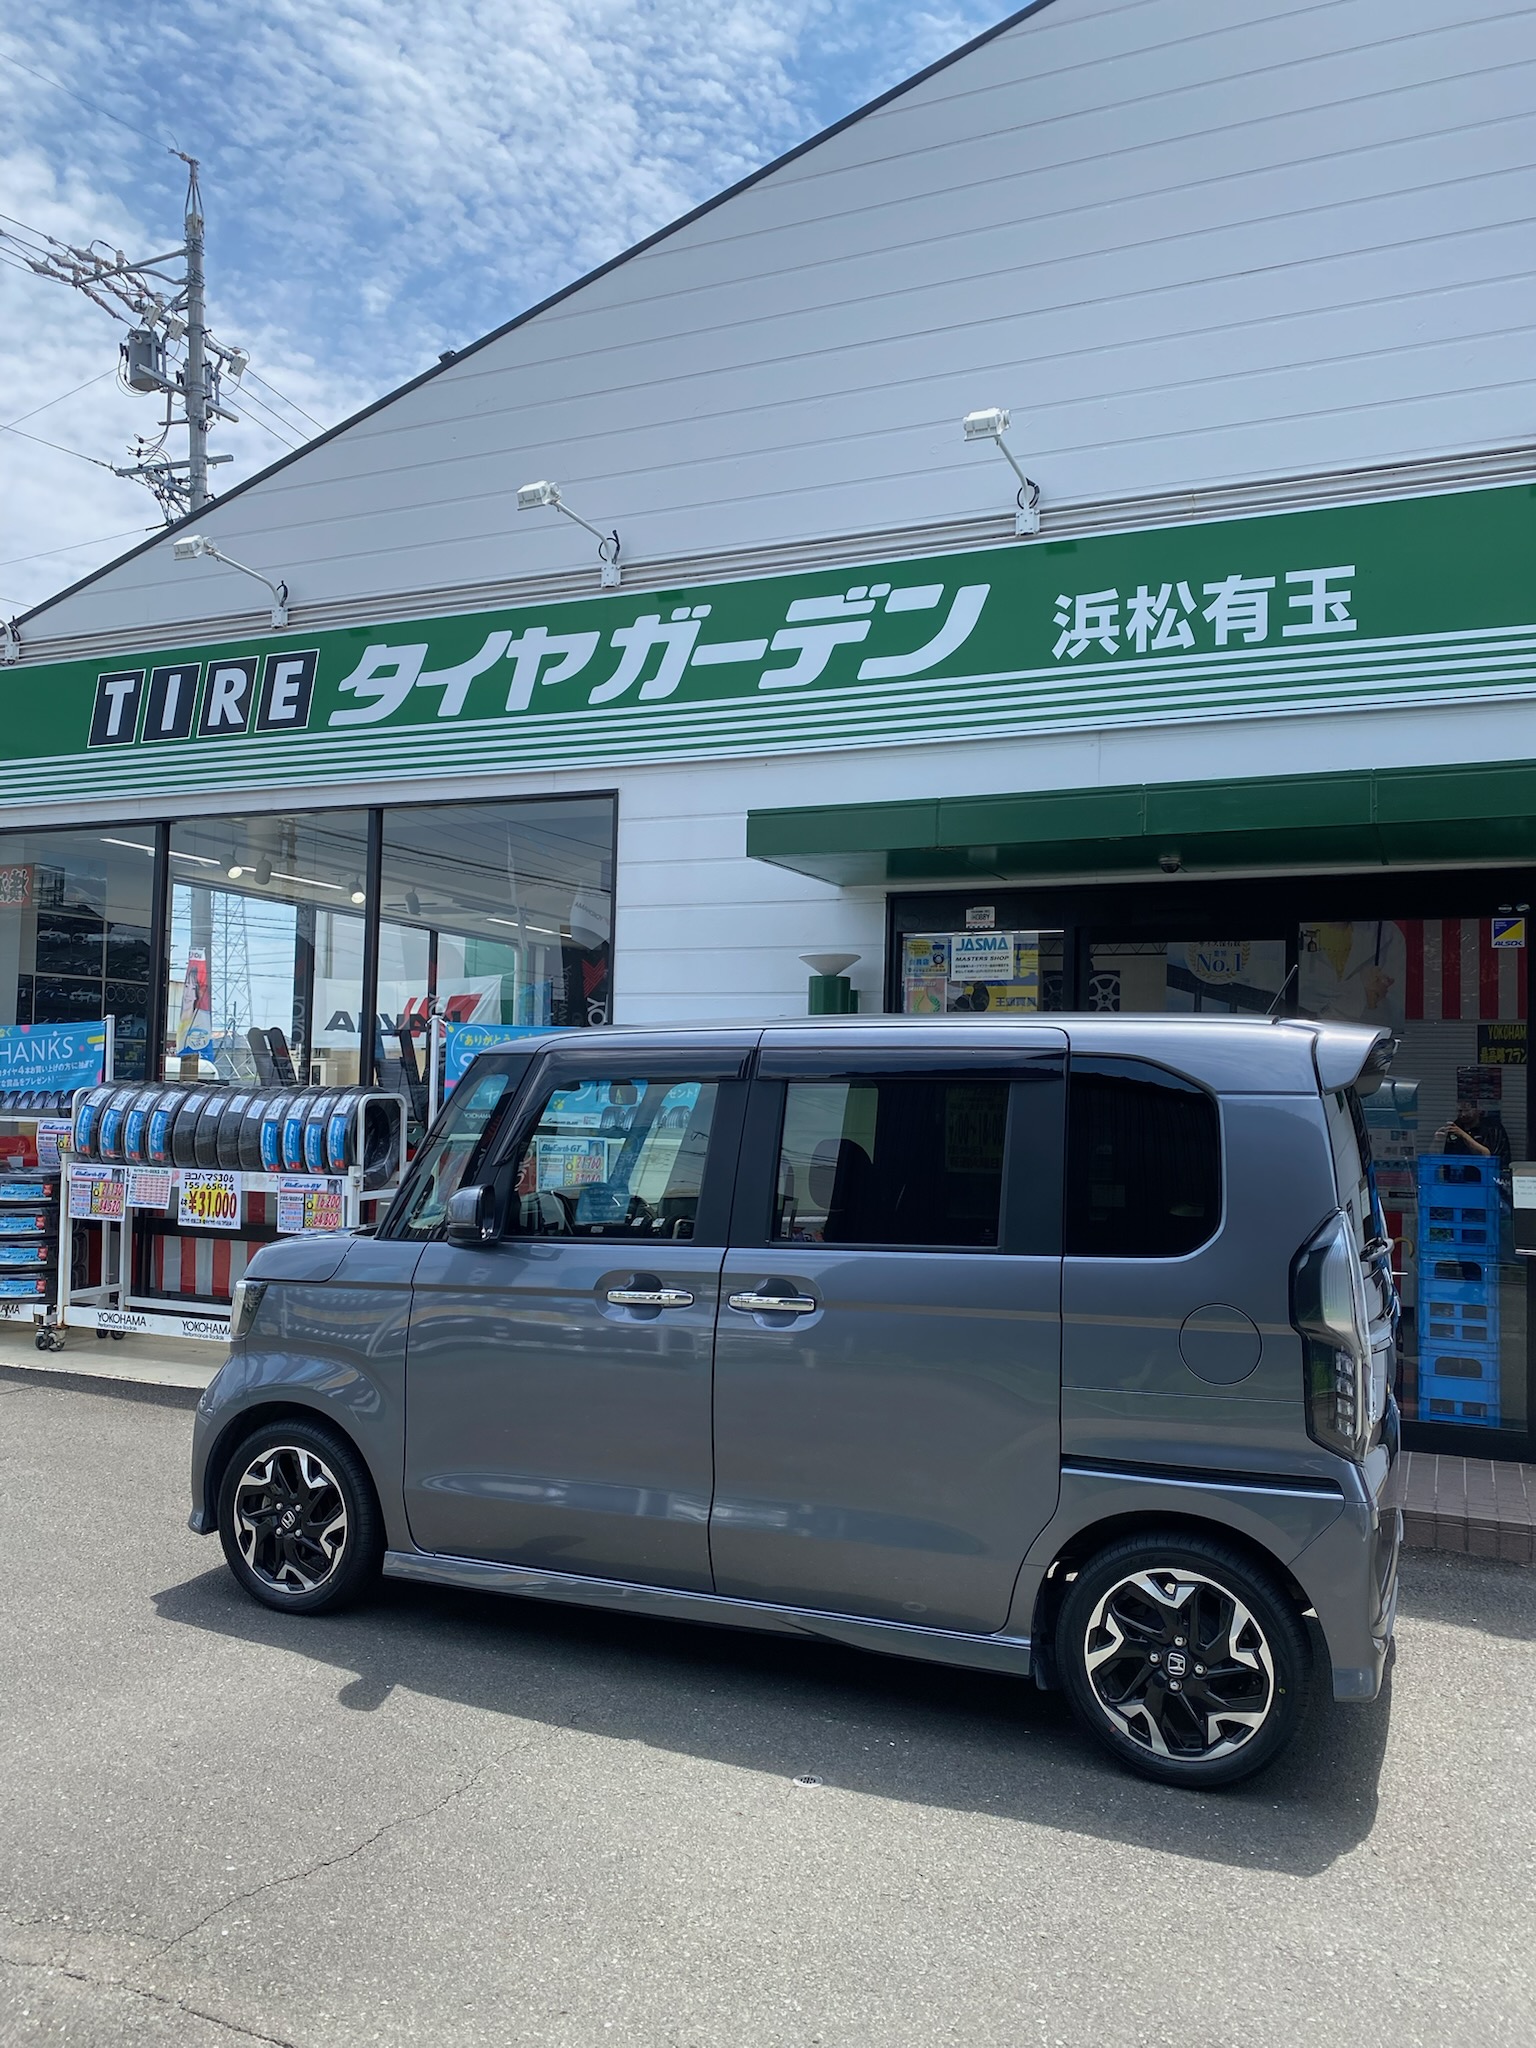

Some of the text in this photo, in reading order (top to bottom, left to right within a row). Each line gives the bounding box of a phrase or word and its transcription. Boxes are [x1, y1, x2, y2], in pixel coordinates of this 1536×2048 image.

[104, 565, 1357, 737] TIRE タイヤガーデン 浜松有玉
[955, 937, 1009, 951] JASMA
[188, 1190, 237, 1219] ¥31,000
[97, 1312, 147, 1327] YOKOHAMA
